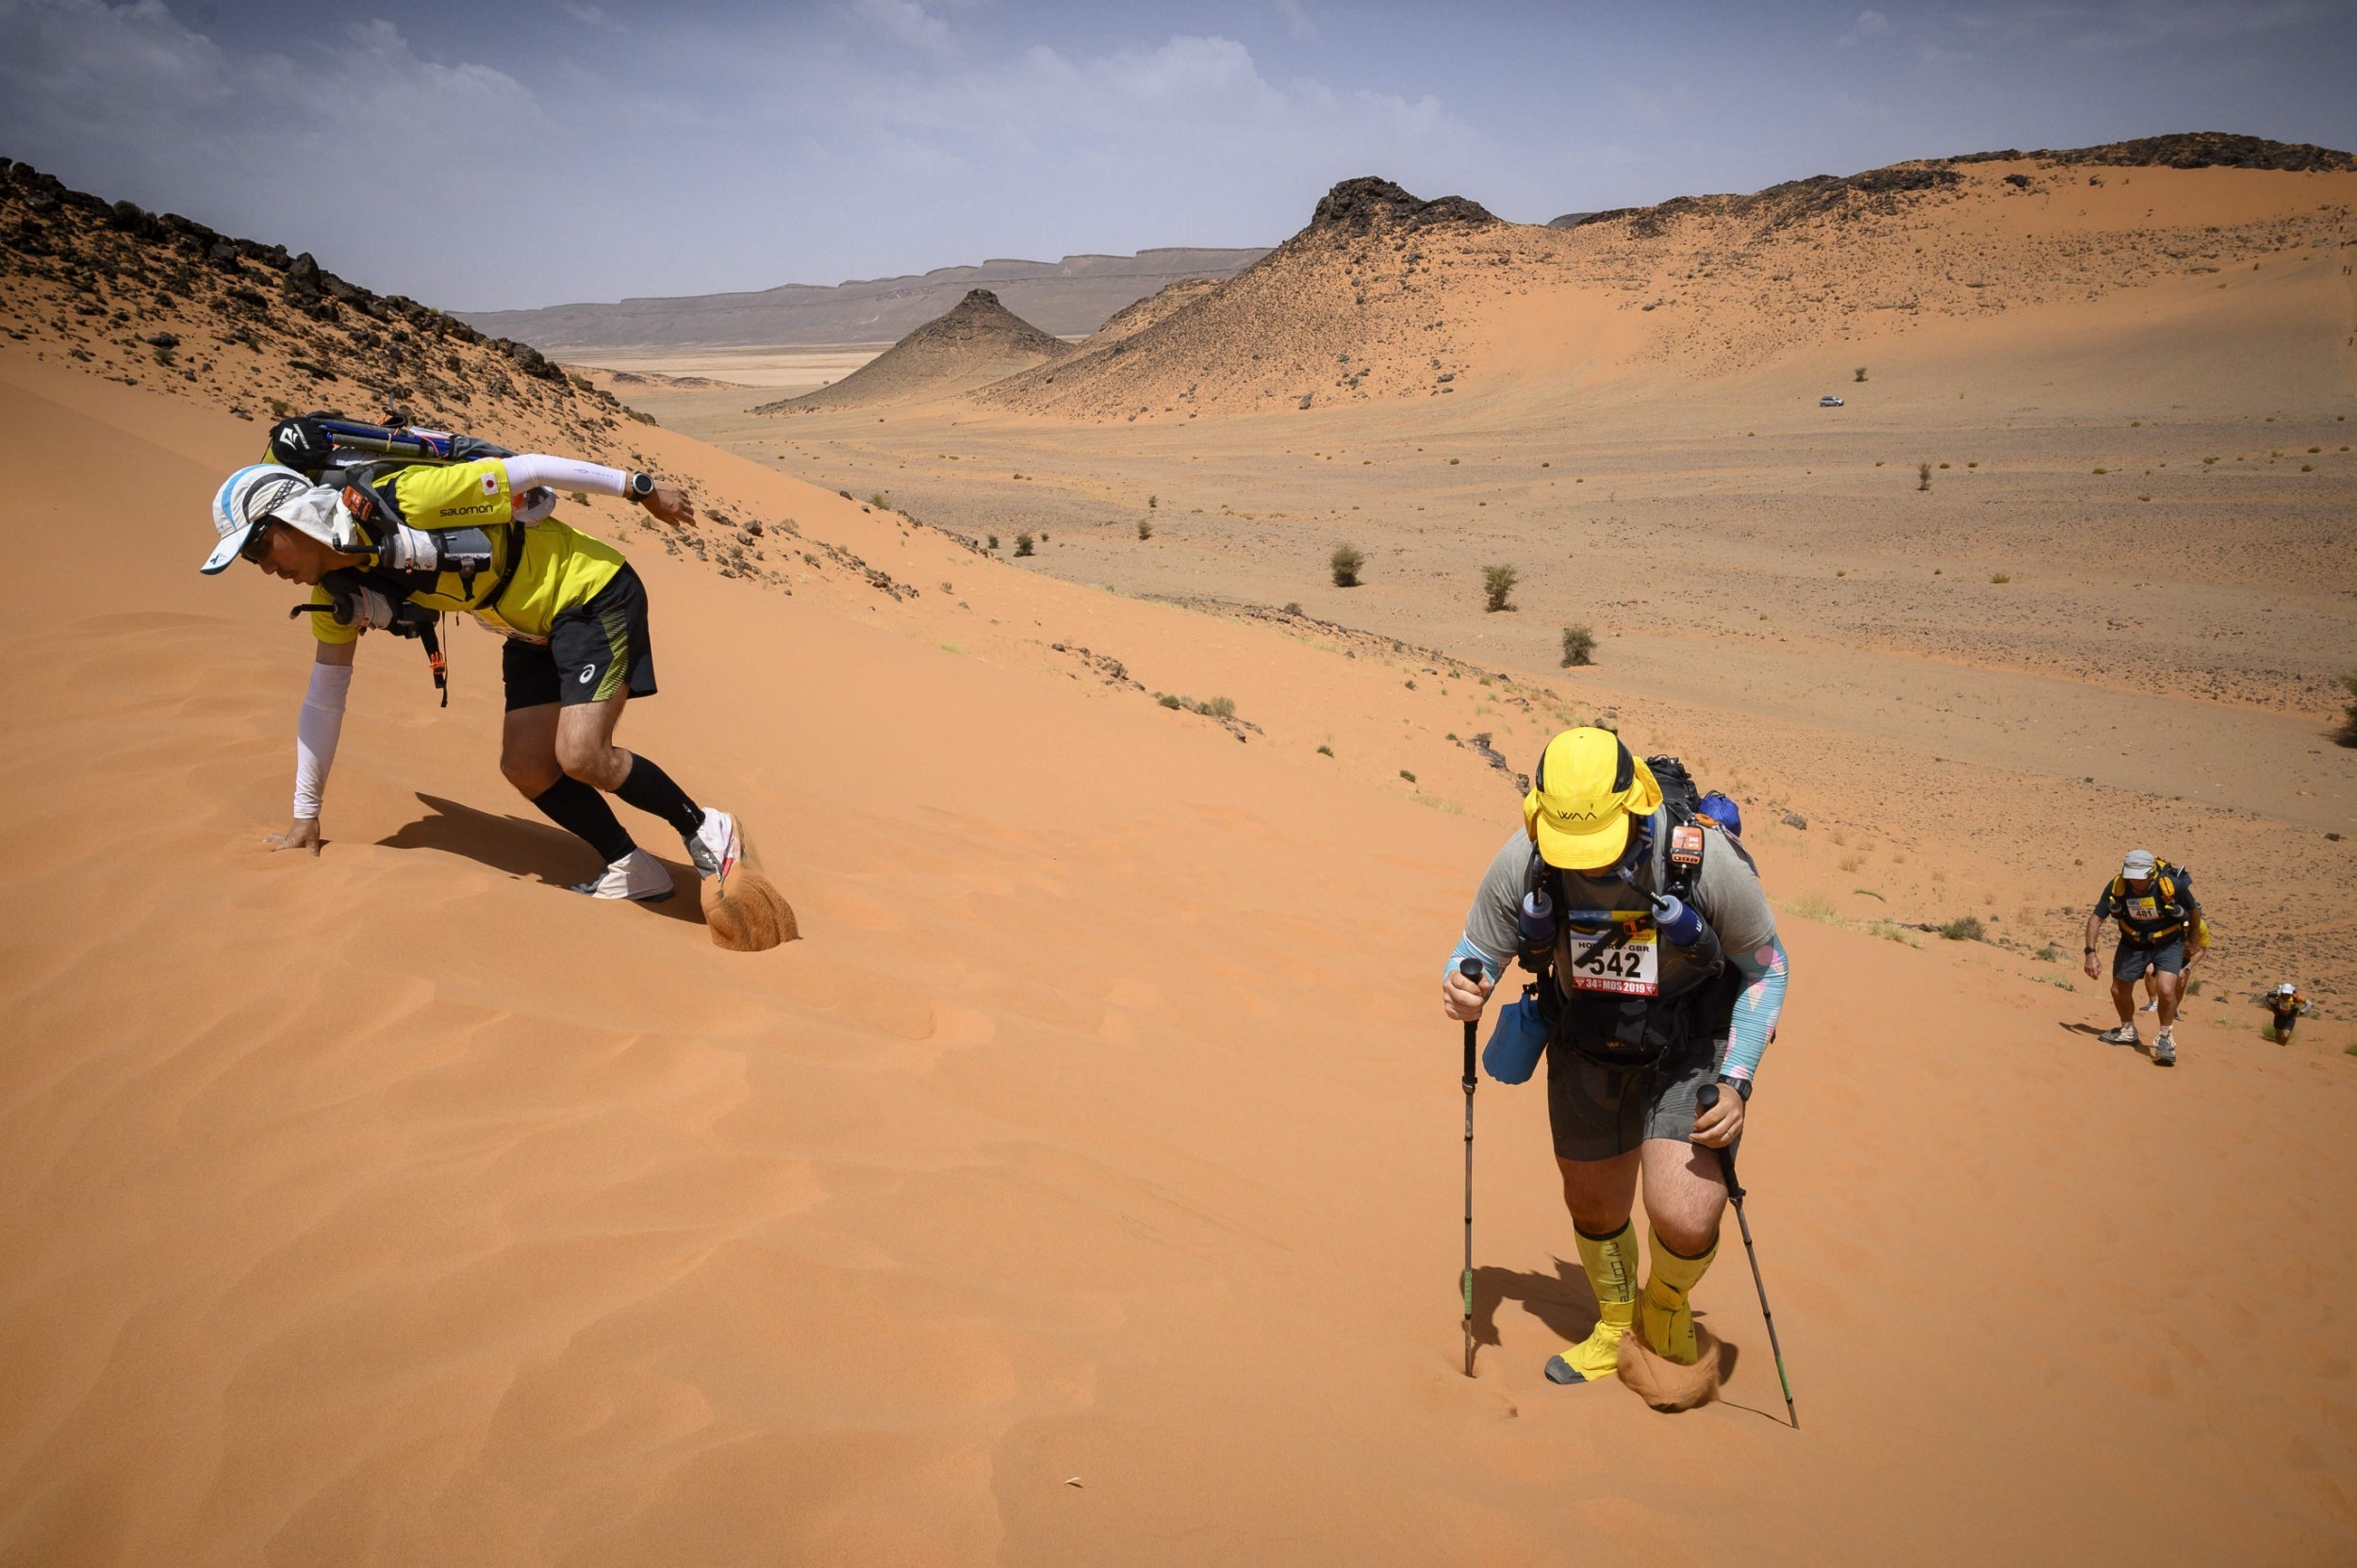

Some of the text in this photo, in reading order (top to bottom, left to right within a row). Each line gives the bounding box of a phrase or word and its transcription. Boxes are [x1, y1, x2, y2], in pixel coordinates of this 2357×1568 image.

[1589, 951, 1641, 978] 542
[1603, 980, 1622, 991] MDS
[1624, 982, 1645, 993] 2019
